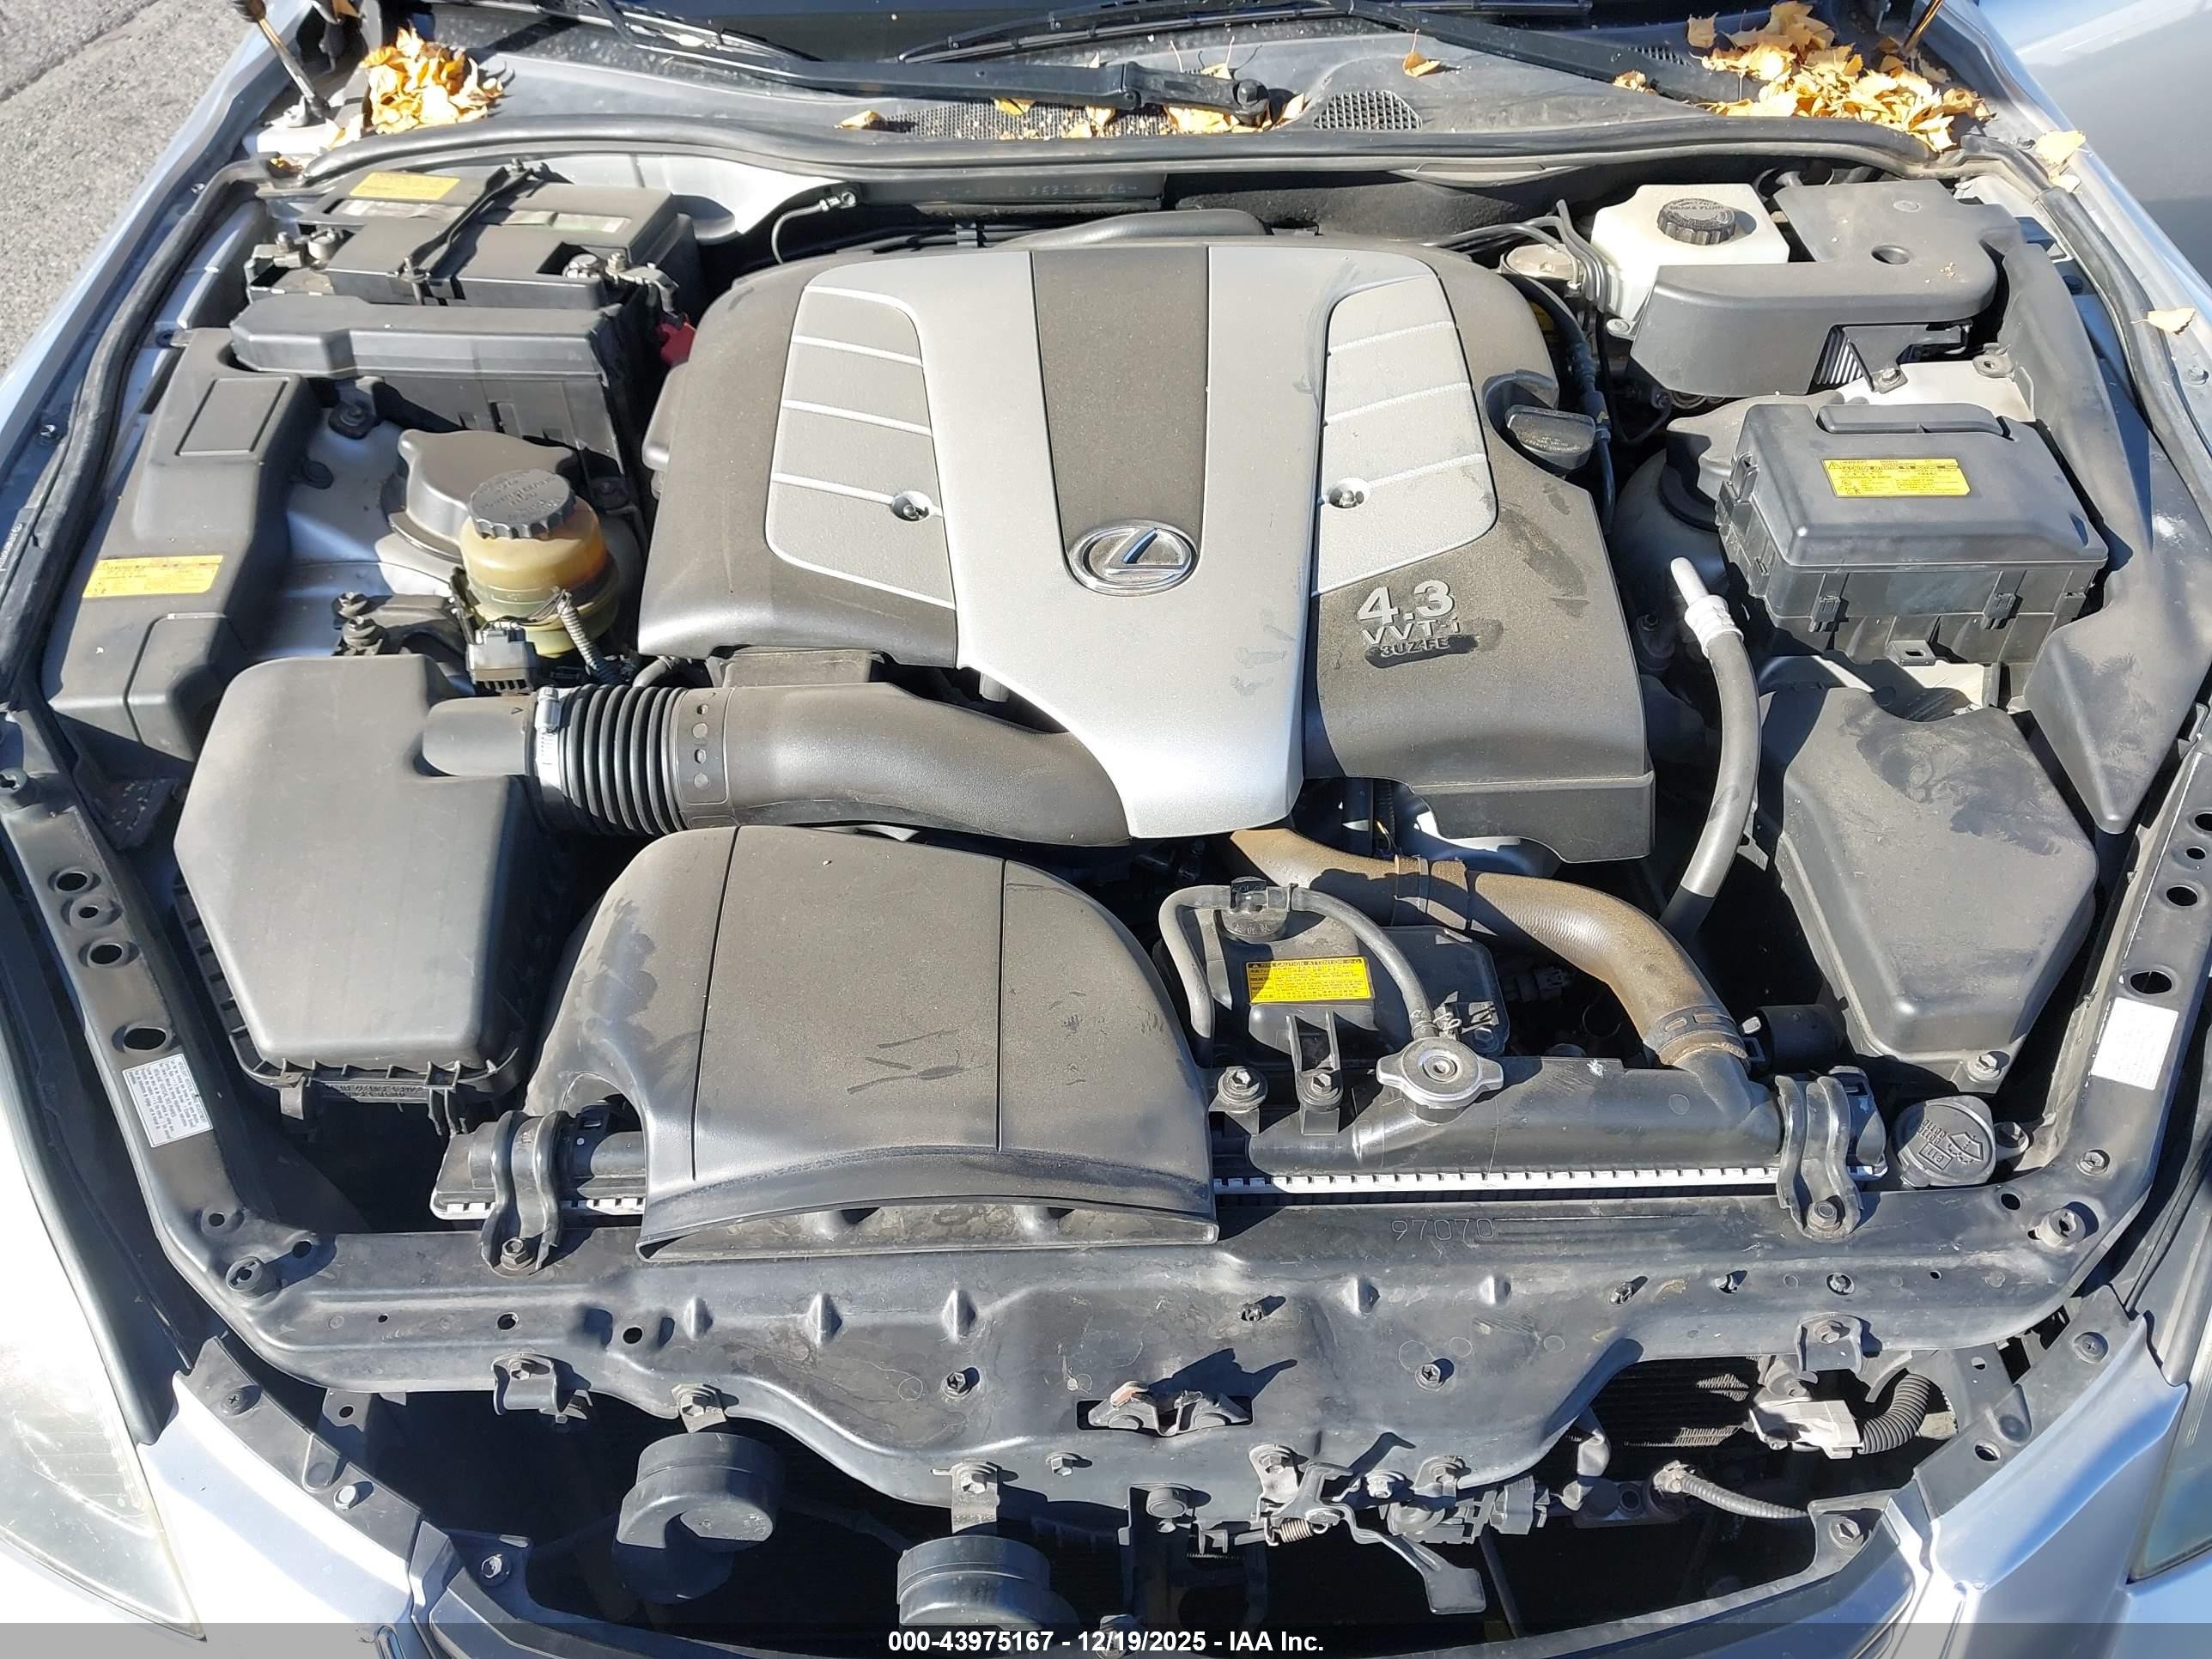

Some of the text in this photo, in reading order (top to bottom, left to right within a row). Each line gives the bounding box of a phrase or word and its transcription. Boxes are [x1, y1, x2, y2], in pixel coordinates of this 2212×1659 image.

[1357, 579, 1455, 626] 4.3
[1361, 616, 1461, 646] VVT-i
[1391, 1218, 1494, 1241] 97070
